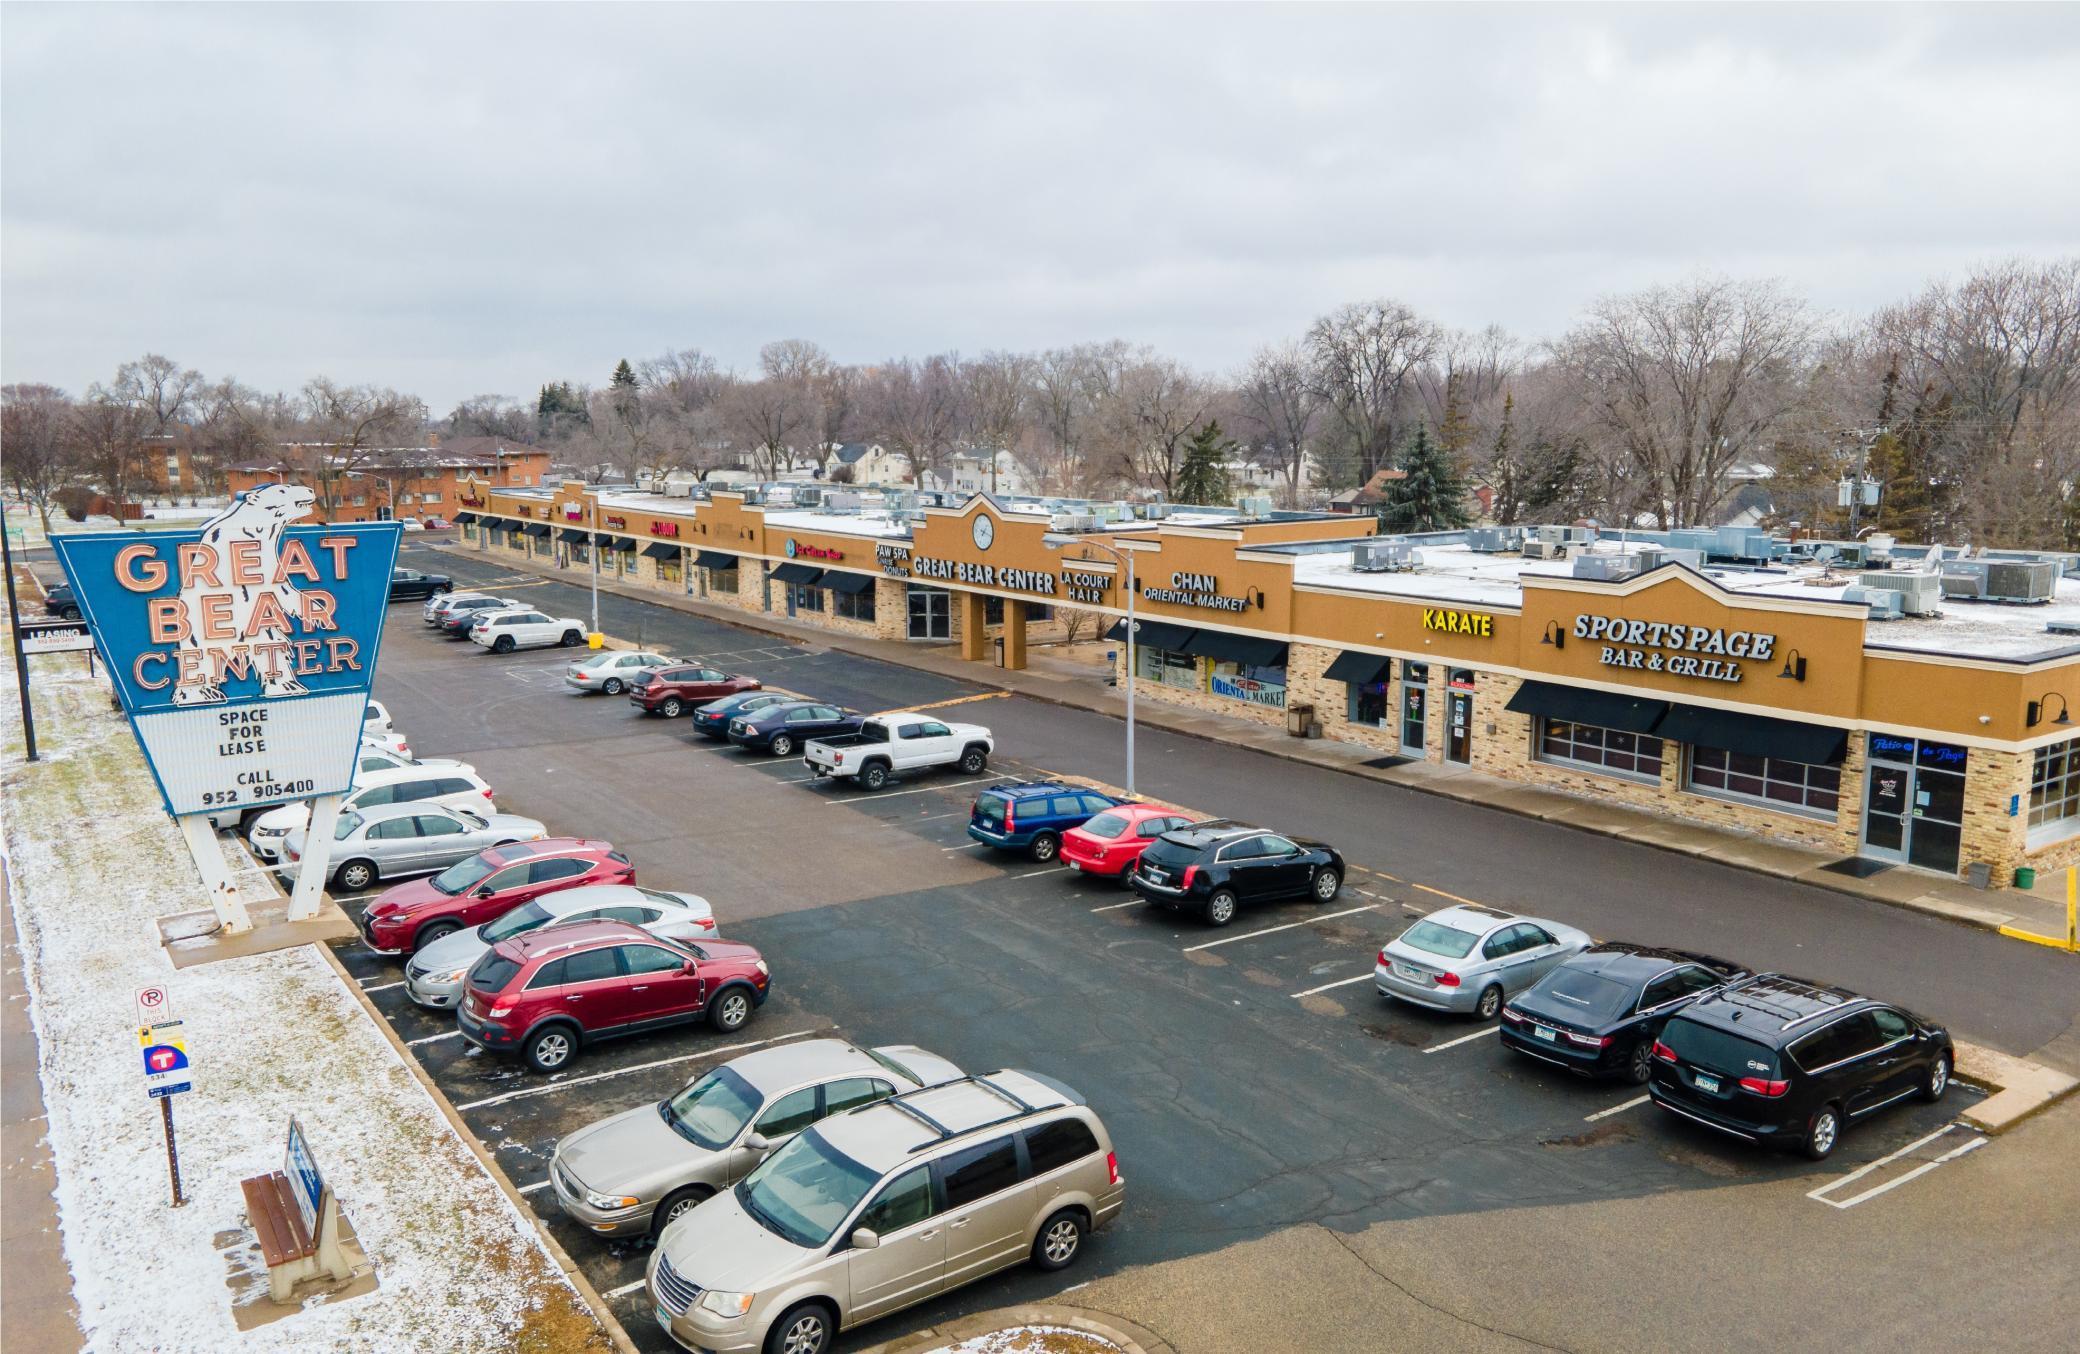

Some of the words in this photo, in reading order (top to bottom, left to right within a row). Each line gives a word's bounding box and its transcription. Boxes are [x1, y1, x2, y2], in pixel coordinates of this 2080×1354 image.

[875, 544, 892, 557] PAW
[893, 547, 909, 560] SPA
[114, 536, 357, 593] GREAT
[883, 565, 909, 577] DONUTS
[914, 556, 954, 578] GREAT
[958, 562, 994, 584] BEAR
[999, 567, 1055, 593] CENTER
[1060, 571, 1072, 584] LA
[1075, 573, 1110, 589] COURT
[1171, 572, 1215, 593] CHAN
[1068, 587, 1101, 603] HAIR
[1143, 588, 1195, 605] ORIENTAL
[1197, 594, 1245, 612] MARKET
[148, 590, 339, 644] BEAR
[1423, 608, 1492, 637] KARATE
[30, 628, 80, 640] LEASING
[1573, 614, 1776, 660] SPORTSPAGE
[133, 637, 362, 690] CENTER
[1599, 647, 1644, 669] BAR
[1648, 654, 1663, 671] &
[1667, 656, 1742, 682] GRILL
[1212, 676, 1250, 700] ORIENTA
[1253, 690, 1286, 708] MARKET
[219, 709, 268, 726] SPACE
[229, 725, 263, 740] FOR
[219, 740, 266, 757] LEASE
[1873, 738, 1902, 751] Patio
[237, 770, 275, 785] CALL
[202, 790, 238, 805] 952
[253, 779, 314, 799] 905400
[152, 1052, 173, 1069] T
